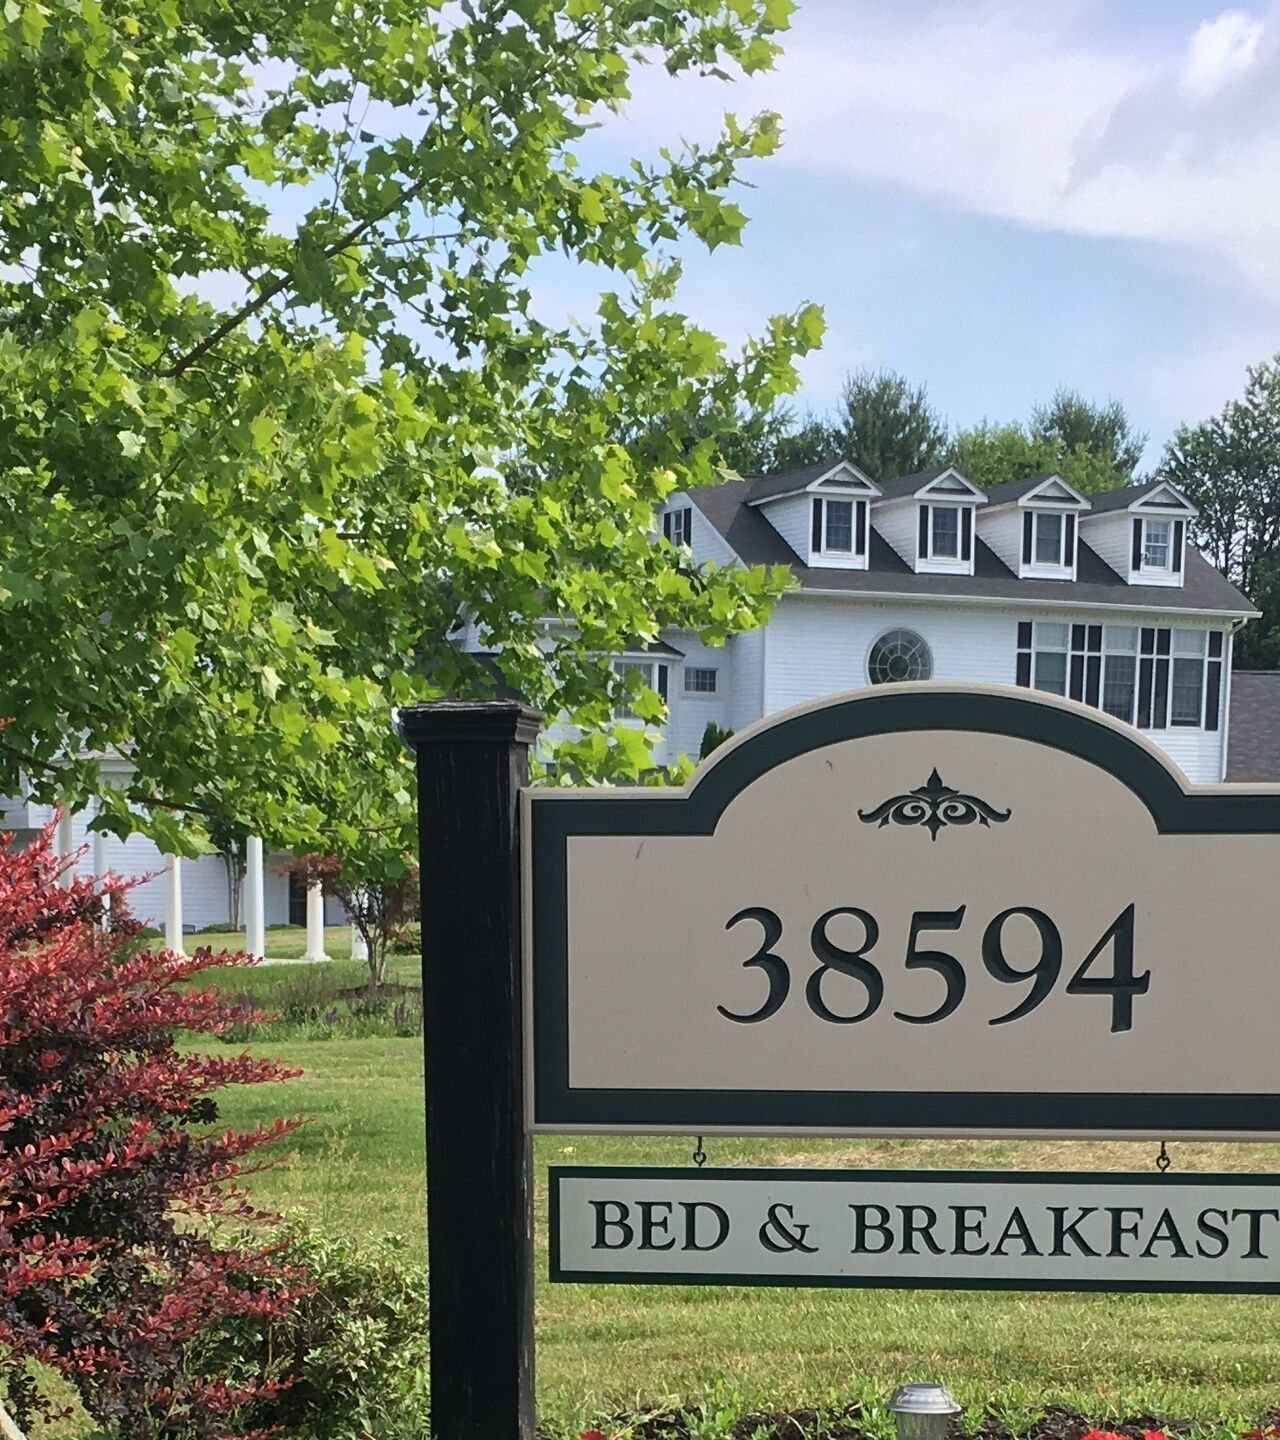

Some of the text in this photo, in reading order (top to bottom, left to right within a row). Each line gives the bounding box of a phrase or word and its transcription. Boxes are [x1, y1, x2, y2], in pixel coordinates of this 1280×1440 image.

[716, 902, 1152, 1035] 38594
[587, 1199, 1280, 1260] BED & BREAKFAST
